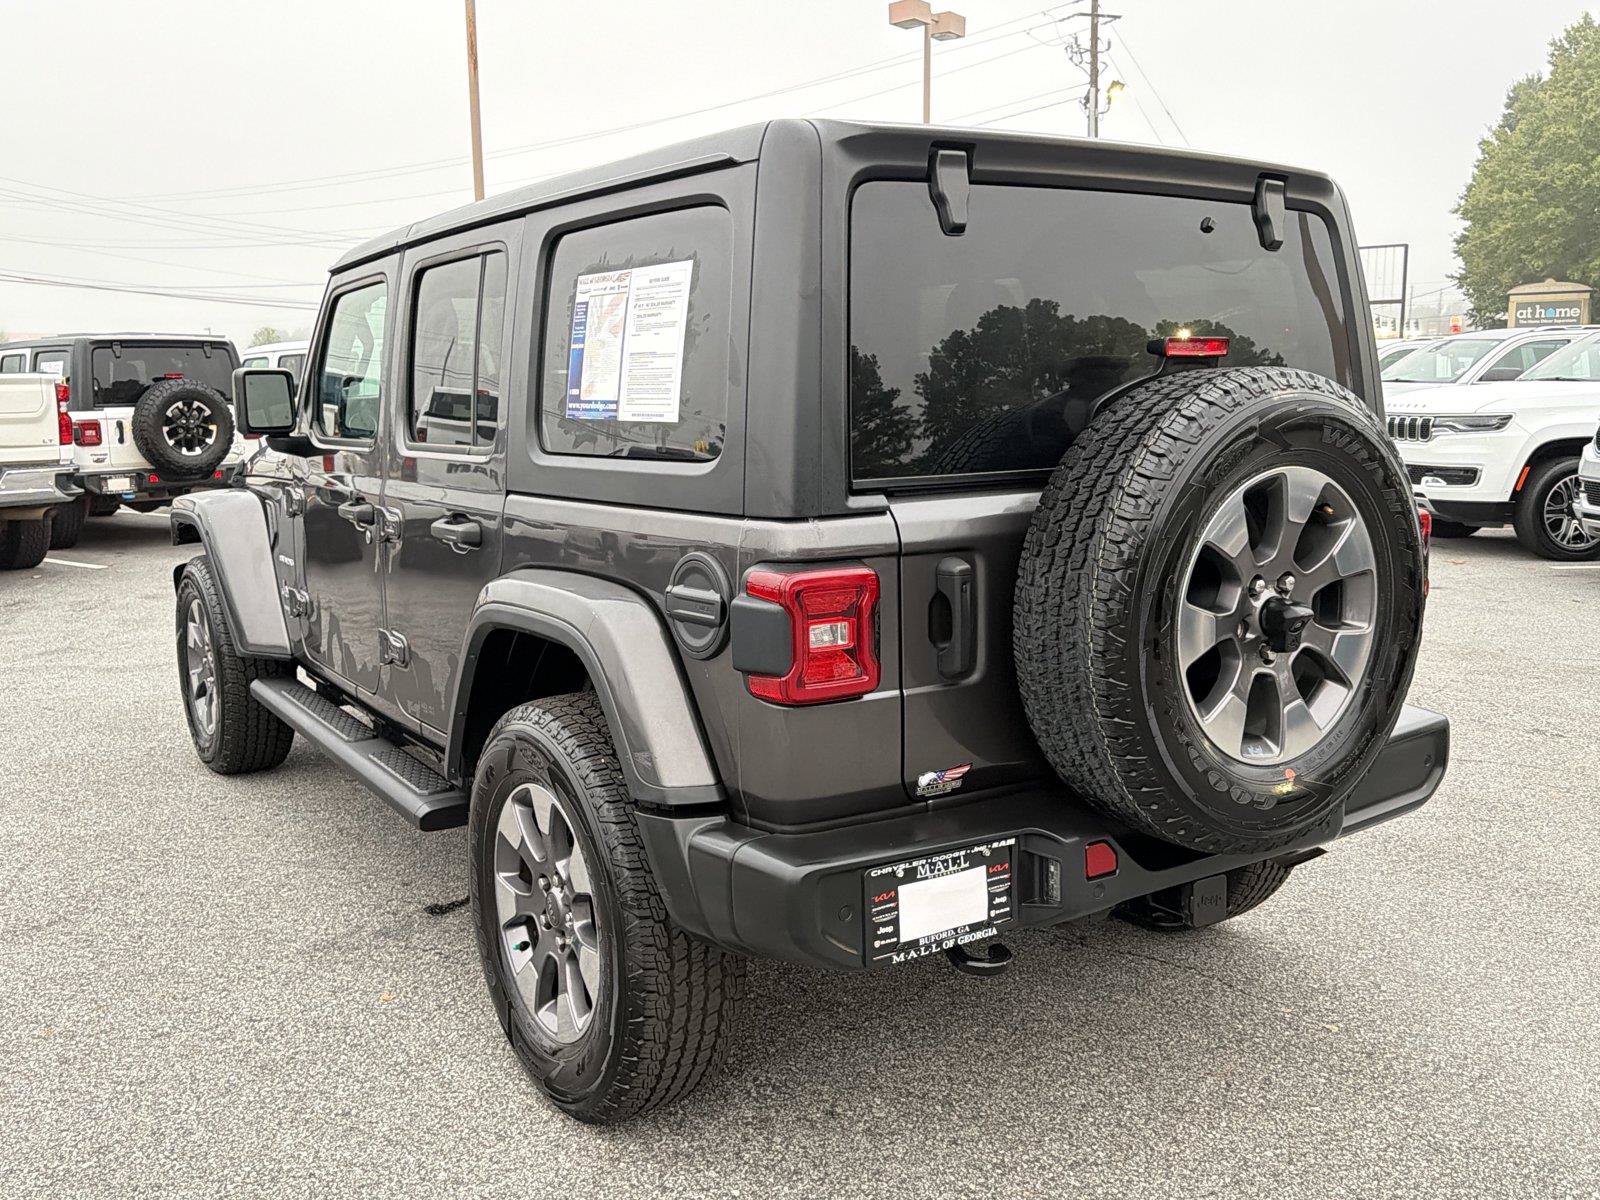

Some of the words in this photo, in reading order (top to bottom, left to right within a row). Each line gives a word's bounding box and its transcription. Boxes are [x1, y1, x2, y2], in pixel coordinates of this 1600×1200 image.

[1516, 306, 1532, 319] at
[1535, 304, 1581, 318] home
[870, 859, 927, 877] CHRYSLER
[931, 850, 966, 863] DODGE
[971, 844, 987, 854] Jeep
[991, 837, 1016, 849] RAM
[992, 895, 1008, 905] Jeep
[876, 925, 894, 935] Jeep
[957, 925, 971, 934] GA
[942, 938, 956, 950] OF
[957, 926, 998, 946] GEORGIA
